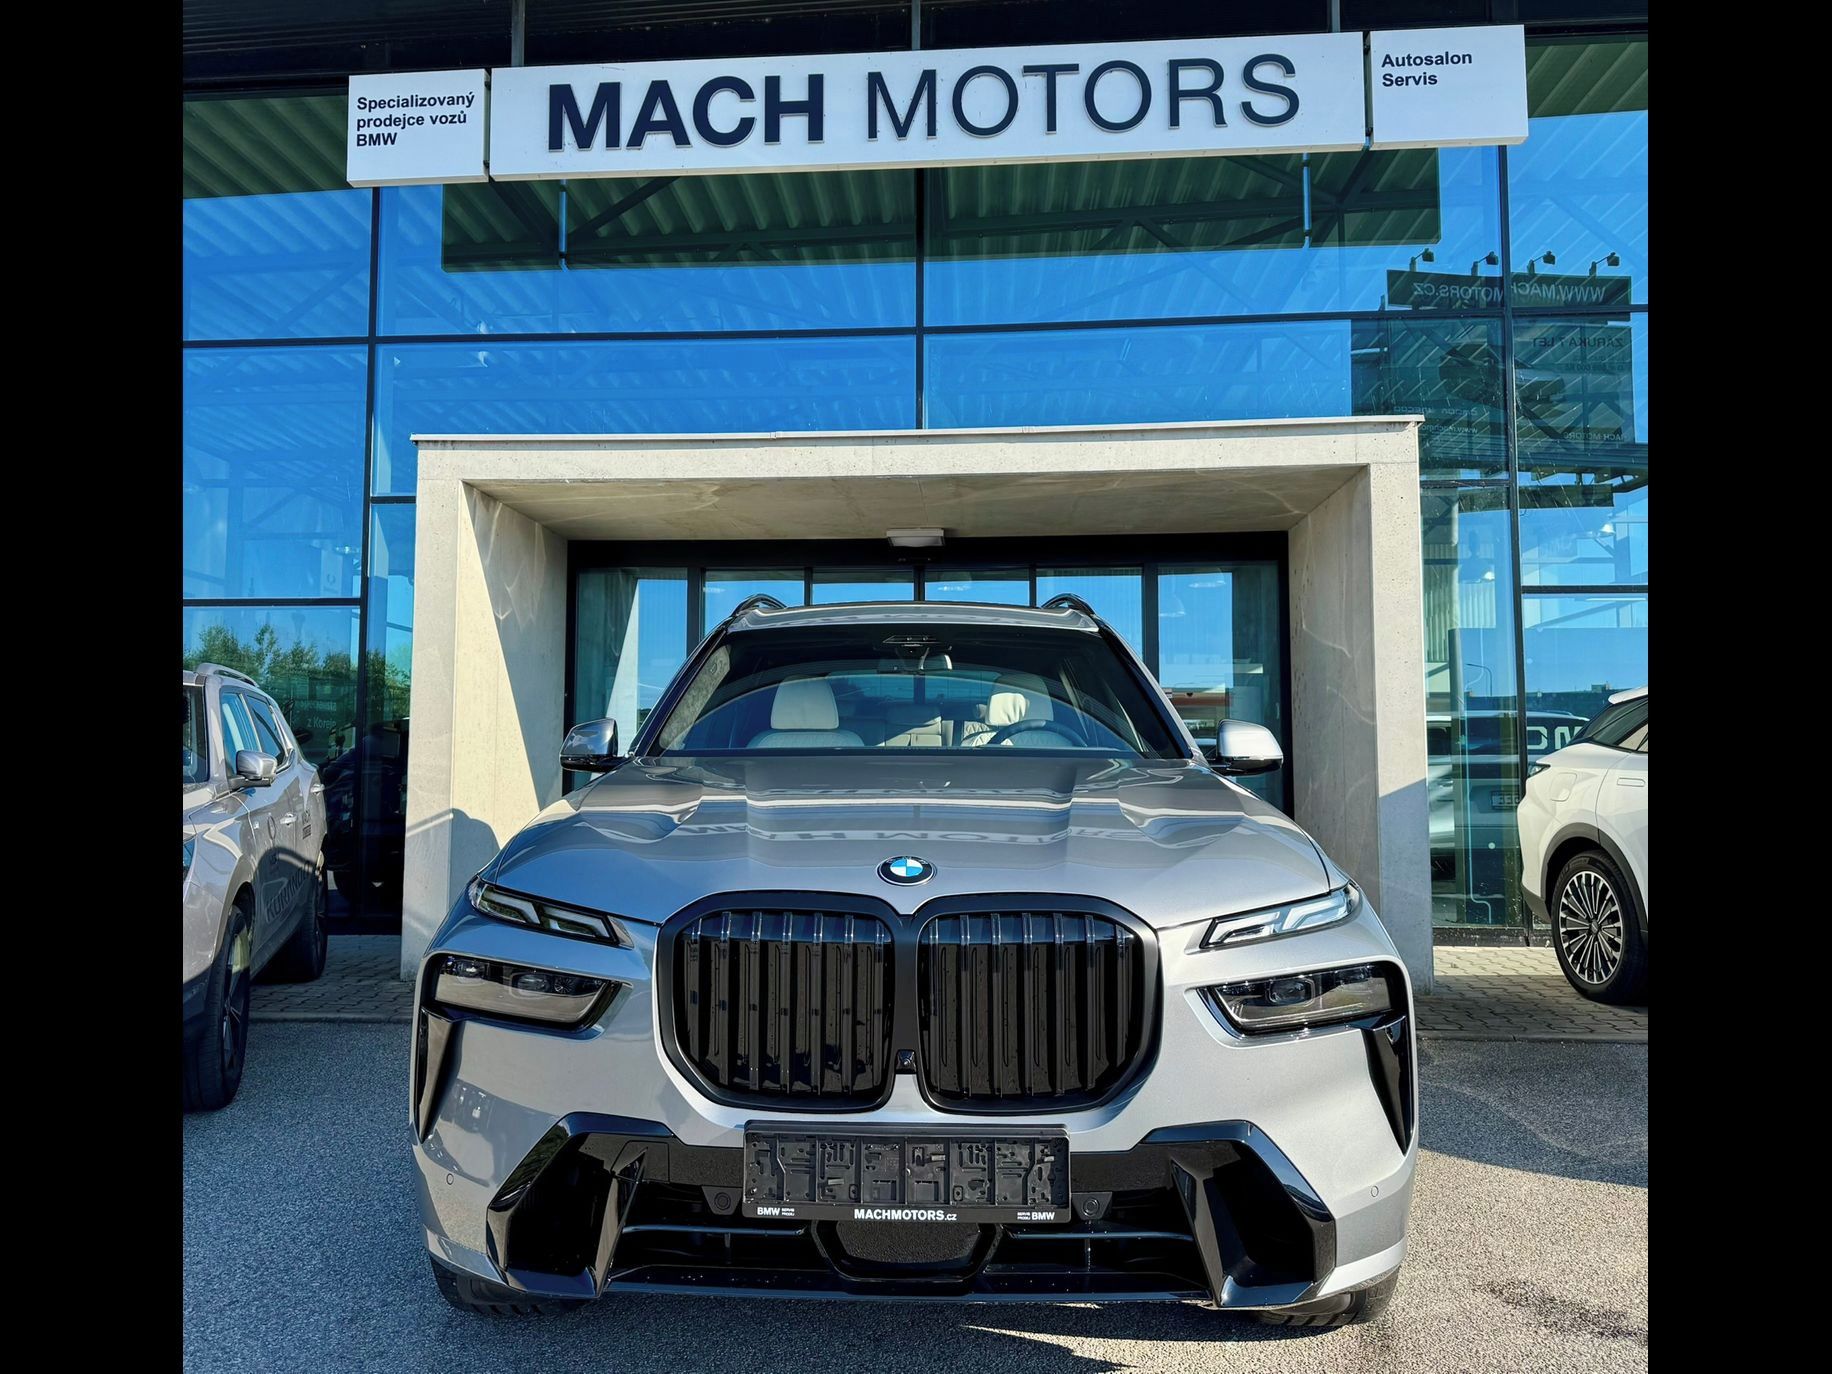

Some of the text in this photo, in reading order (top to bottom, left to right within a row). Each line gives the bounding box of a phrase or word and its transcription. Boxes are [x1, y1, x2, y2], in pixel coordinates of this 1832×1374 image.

[1381, 51, 1473, 68] Autosalon
[1382, 71, 1438, 87] Servis
[357, 91, 475, 113] Specializovaný
[548, 53, 1300, 152] MACH MOTORS
[356, 110, 467, 131] prodejce vozů
[356, 132, 397, 147] BMW
[757, 1206, 780, 1216] BMW
[853, 1208, 958, 1222] MACHMOTORS.cz
[1031, 1211, 1055, 1221] BMW
